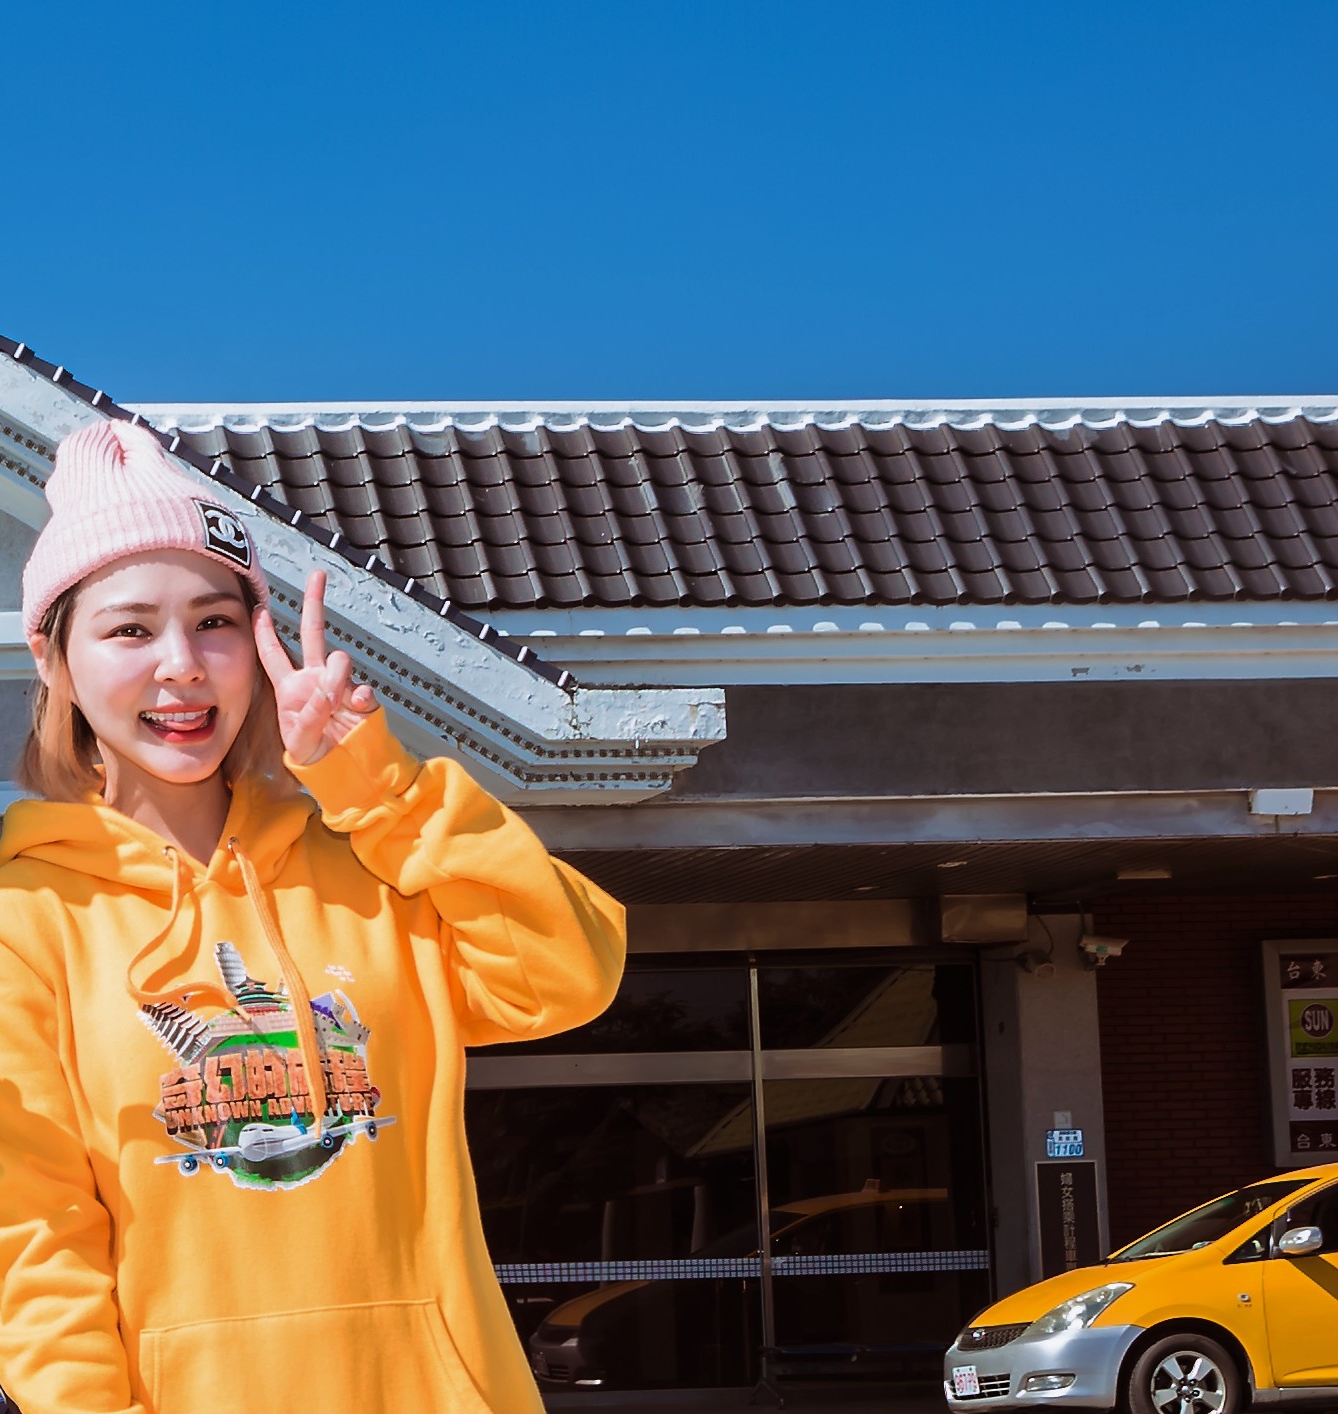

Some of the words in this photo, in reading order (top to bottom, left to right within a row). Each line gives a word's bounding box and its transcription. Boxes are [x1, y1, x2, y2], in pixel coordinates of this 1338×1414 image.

[1304, 1009, 1330, 1031] SUN
[1292, 1068, 1335, 1089] 服務
[166, 1099, 262, 1129] UNKNOWN
